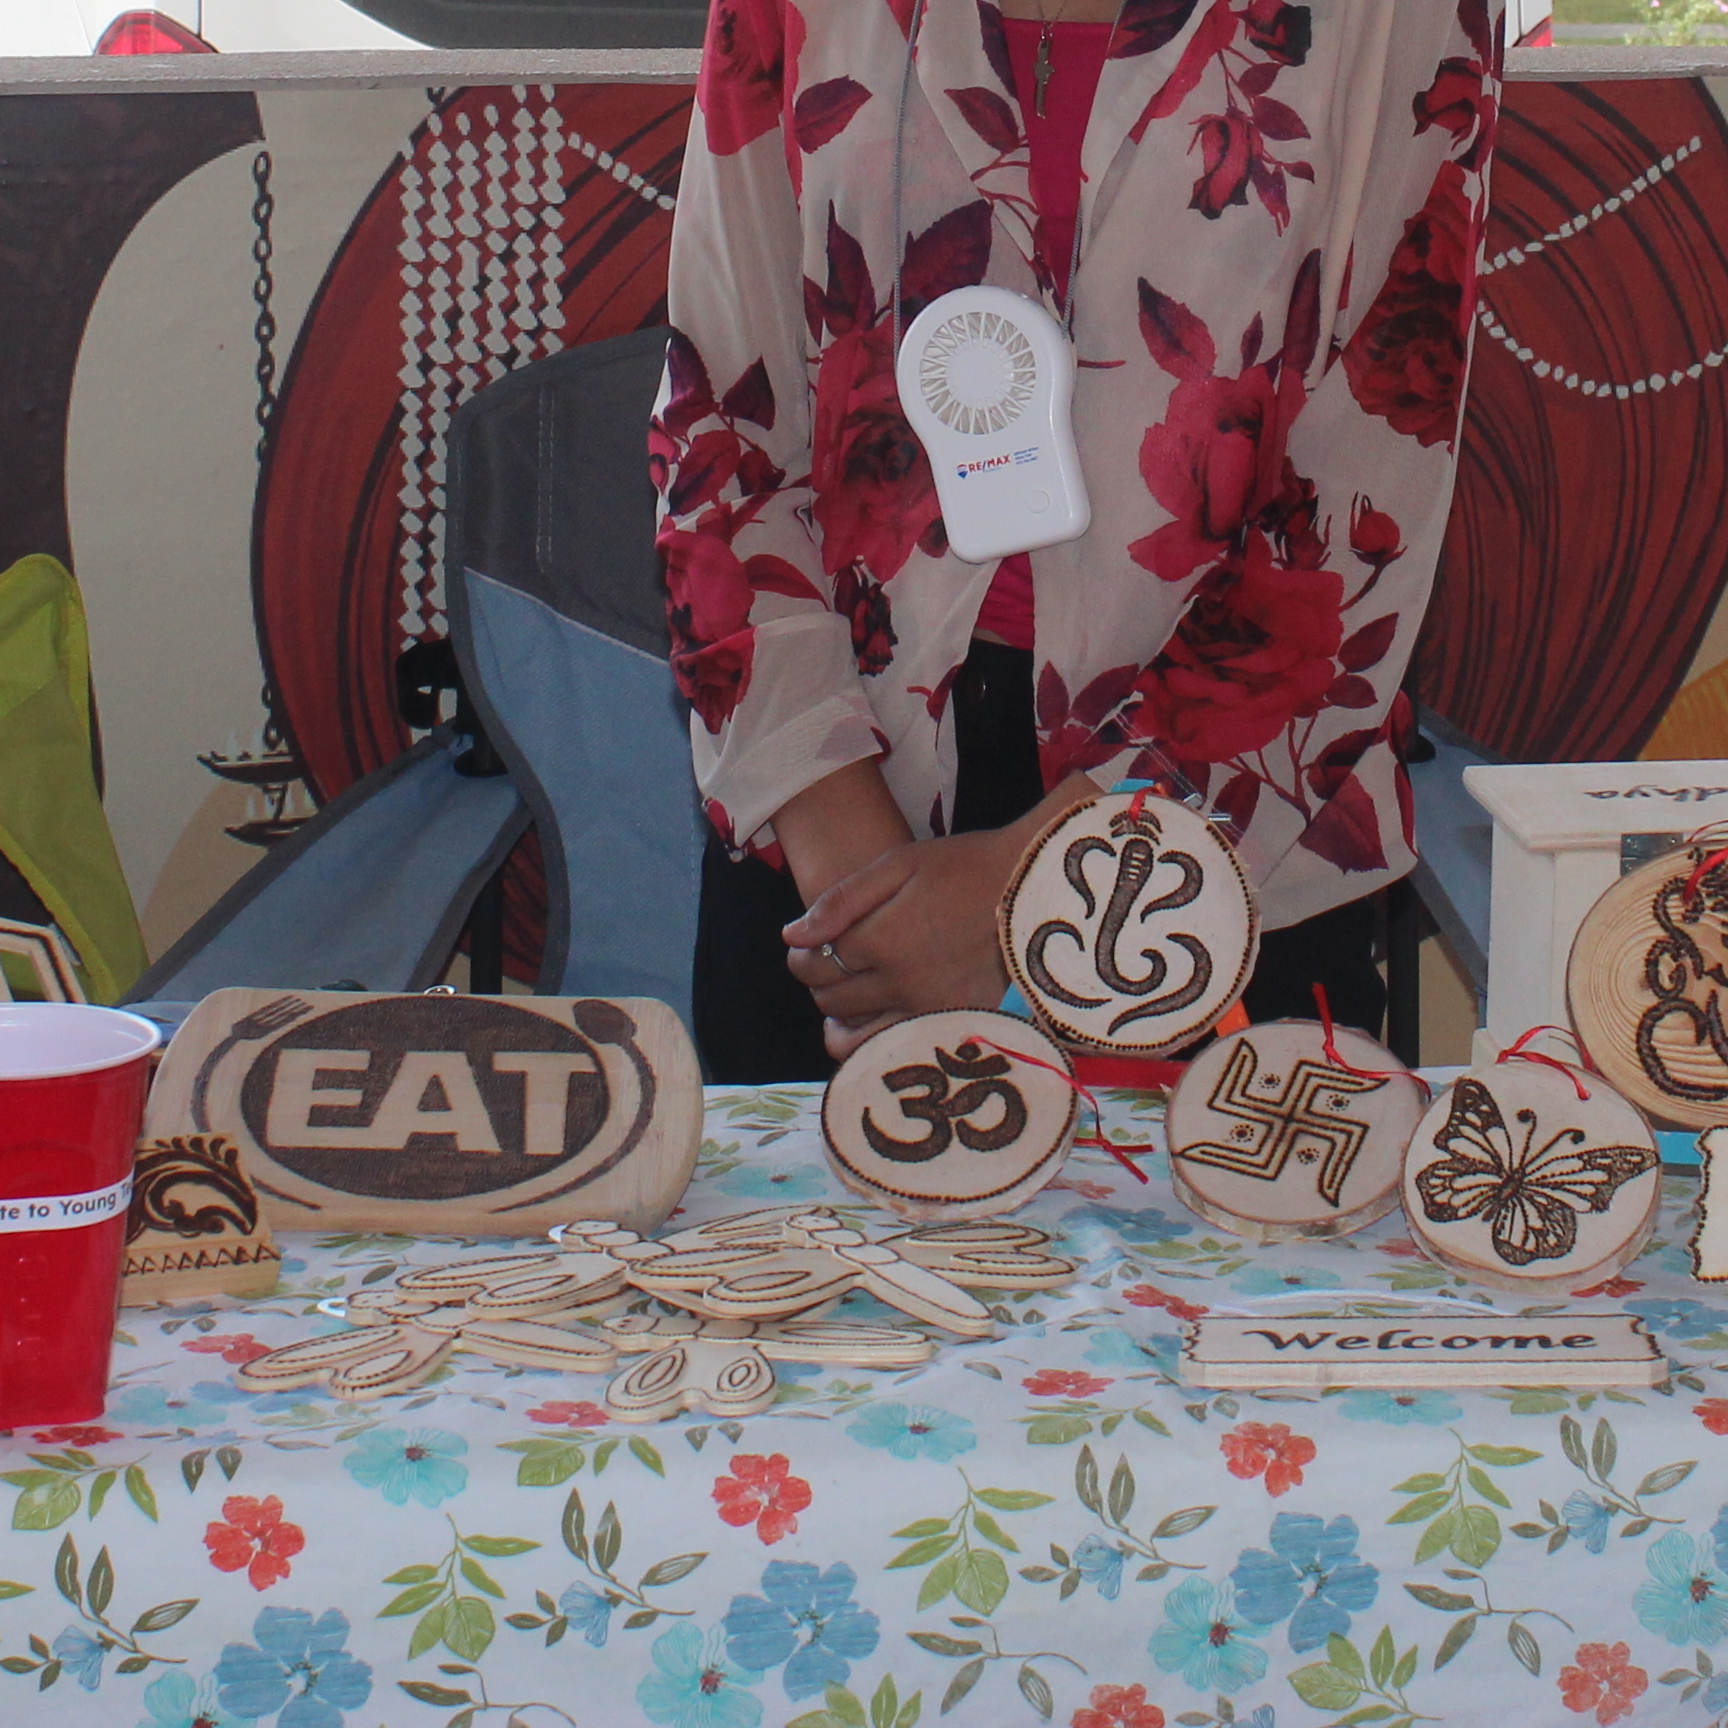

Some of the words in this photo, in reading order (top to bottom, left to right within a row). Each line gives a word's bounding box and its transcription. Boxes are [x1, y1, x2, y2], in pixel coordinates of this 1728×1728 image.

[969, 454, 1011, 472] RE/MAX
[266, 1047, 597, 1155] EAT
[28, 1203, 50, 1218] to
[60, 1192, 116, 1216] Young
[1242, 1328, 1598, 1354] Welcome
